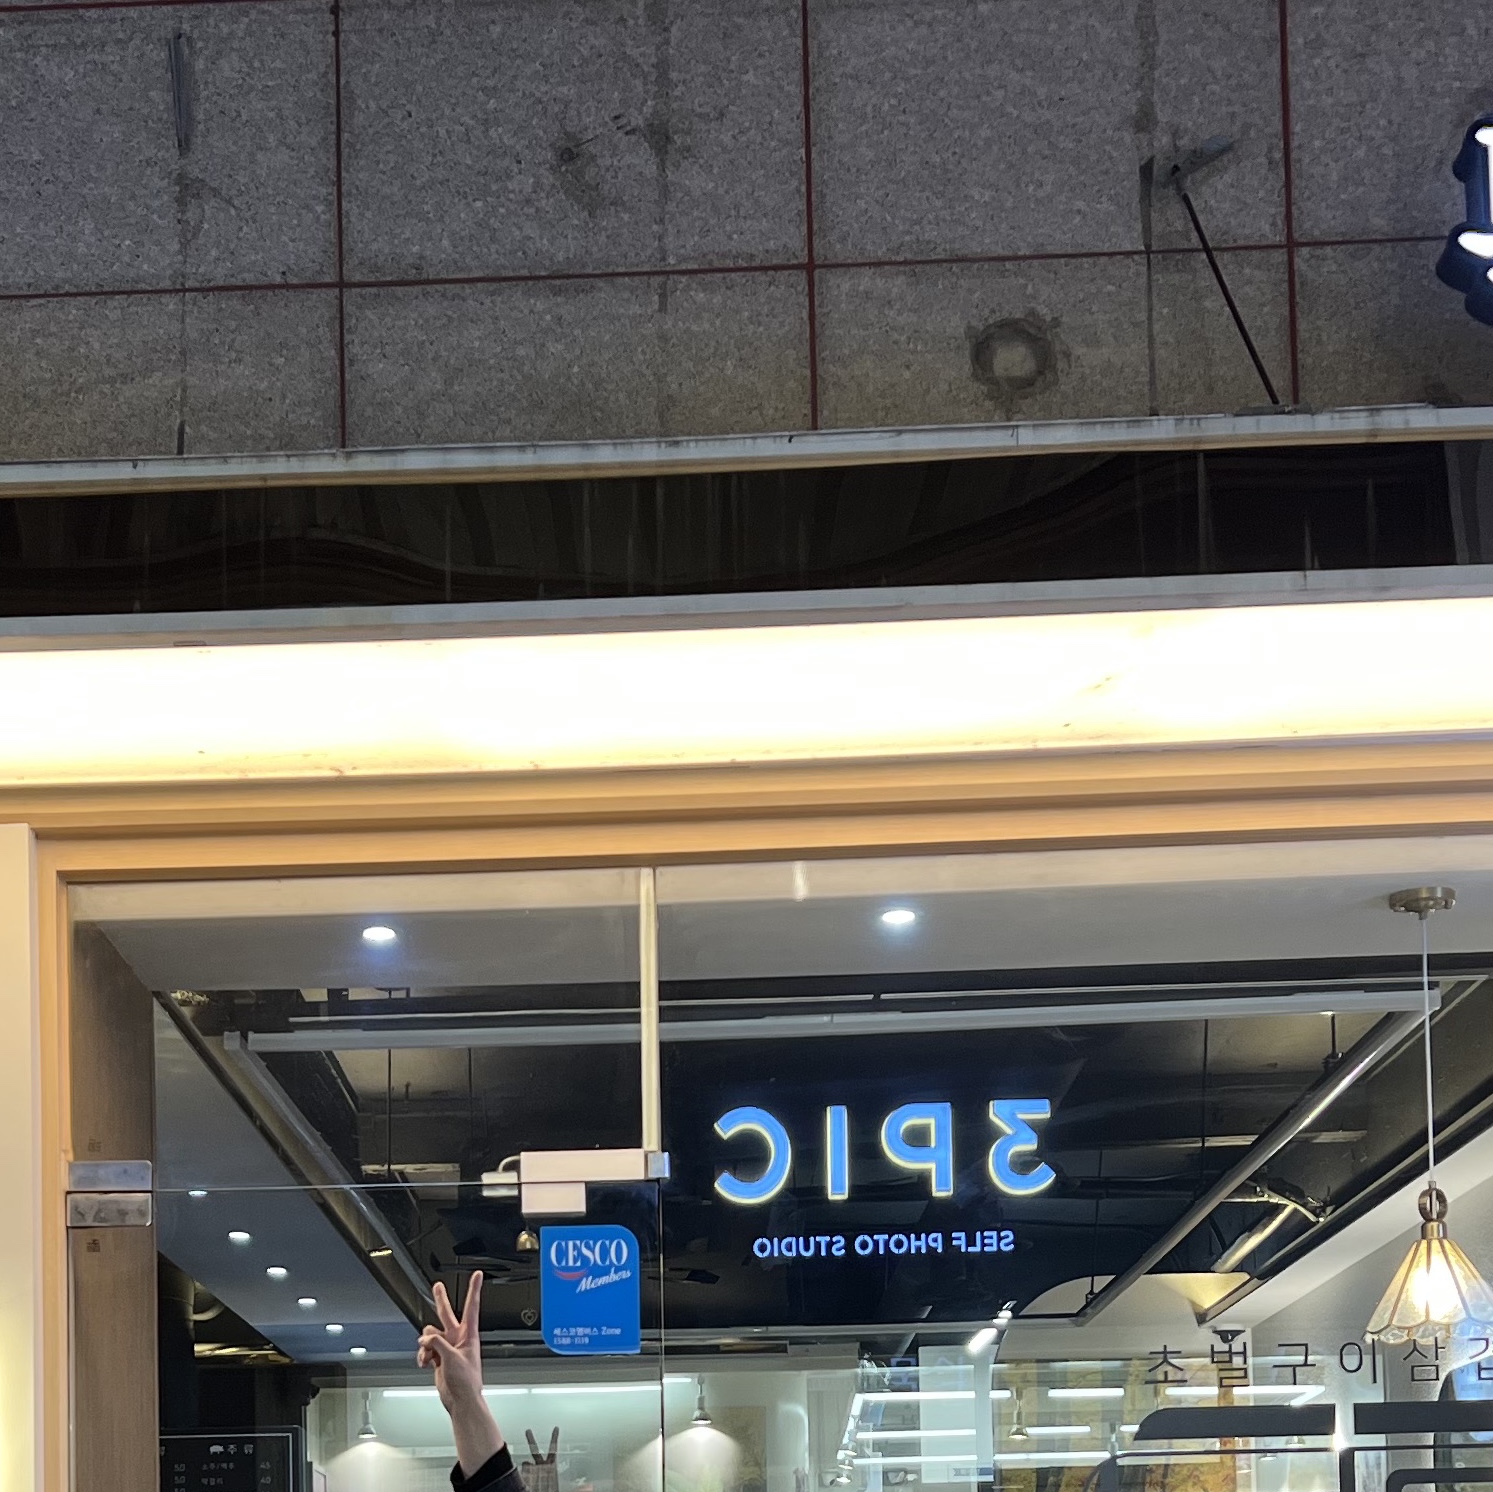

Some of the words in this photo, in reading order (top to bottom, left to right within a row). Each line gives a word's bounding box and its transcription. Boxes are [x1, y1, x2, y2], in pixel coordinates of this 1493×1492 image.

[550, 1239, 628, 1267] CESCO
[575, 1266, 633, 1293] Members
[601, 1326, 622, 1336] Zone
